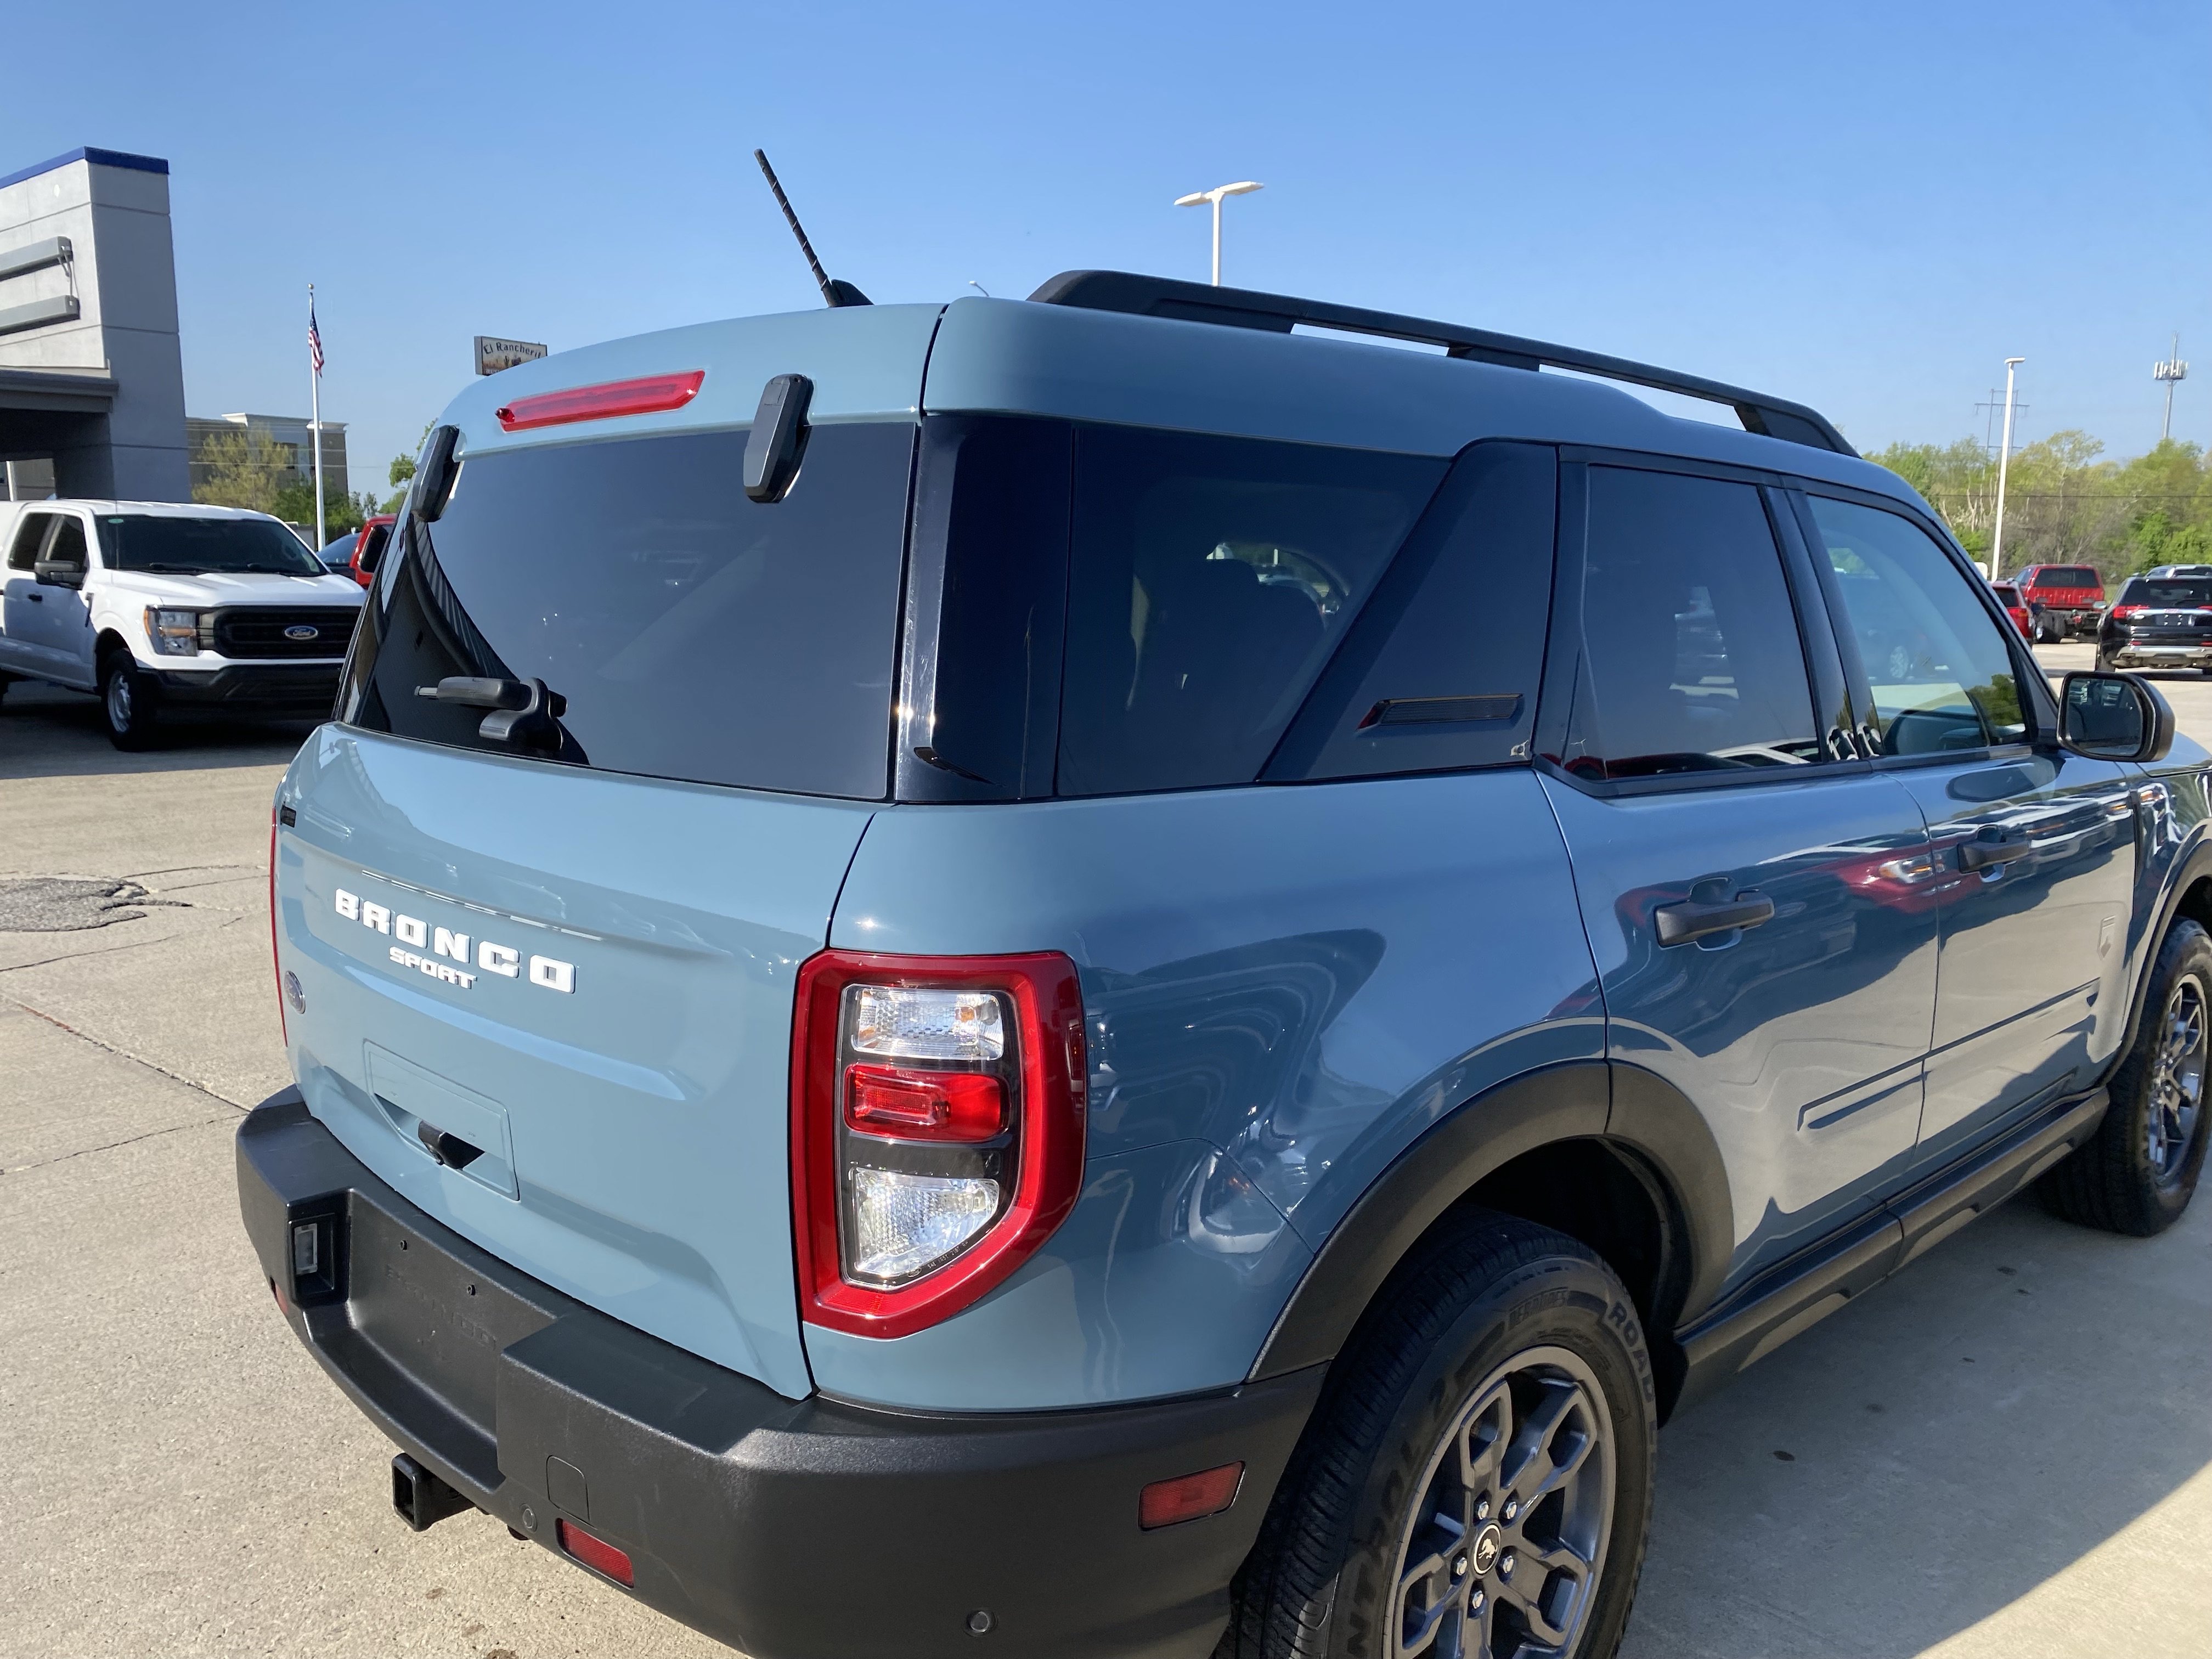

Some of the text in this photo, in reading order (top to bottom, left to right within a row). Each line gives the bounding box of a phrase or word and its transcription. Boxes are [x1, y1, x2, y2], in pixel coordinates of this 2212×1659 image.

[483, 341, 541, 359] El Rancherit
[335, 888, 576, 994] BRONCO
[390, 946, 477, 990] SPORT
[1608, 1301, 1655, 1403] ROAD
